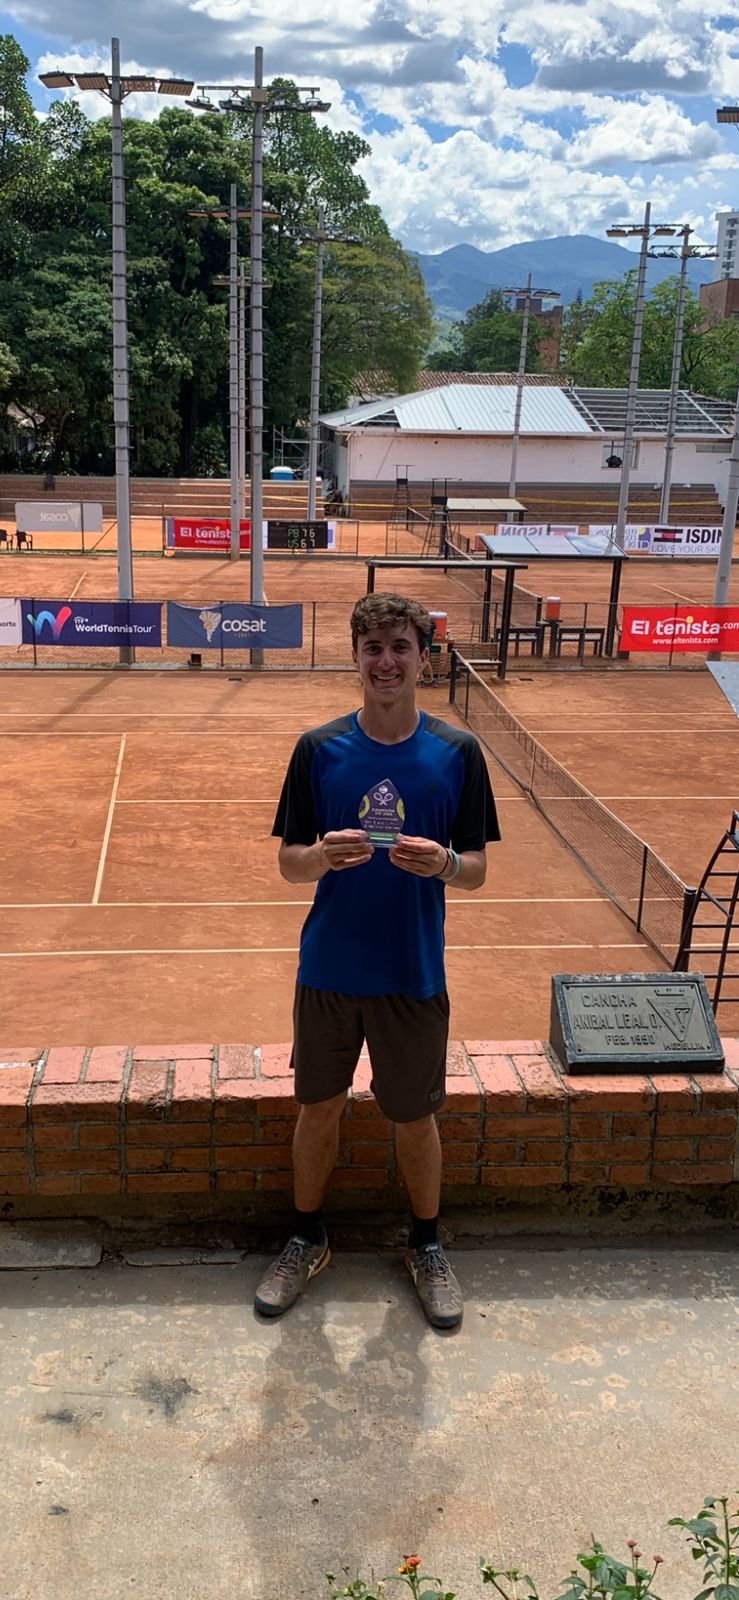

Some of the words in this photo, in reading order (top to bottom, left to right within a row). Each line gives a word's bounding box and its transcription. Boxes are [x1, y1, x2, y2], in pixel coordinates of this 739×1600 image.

[180, 527, 192, 537] El
[651, 544, 676, 553] LOVE
[678, 545, 703, 553] YOUR
[221, 619, 267, 632] cosat
[631, 620, 650, 635] El
[652, 637, 719, 645] www.eltenista.com
[581, 993, 638, 1007] CANCHA
[573, 1013, 615, 1029] ANIBAL
[615, 1013, 648, 1029] LEAL
